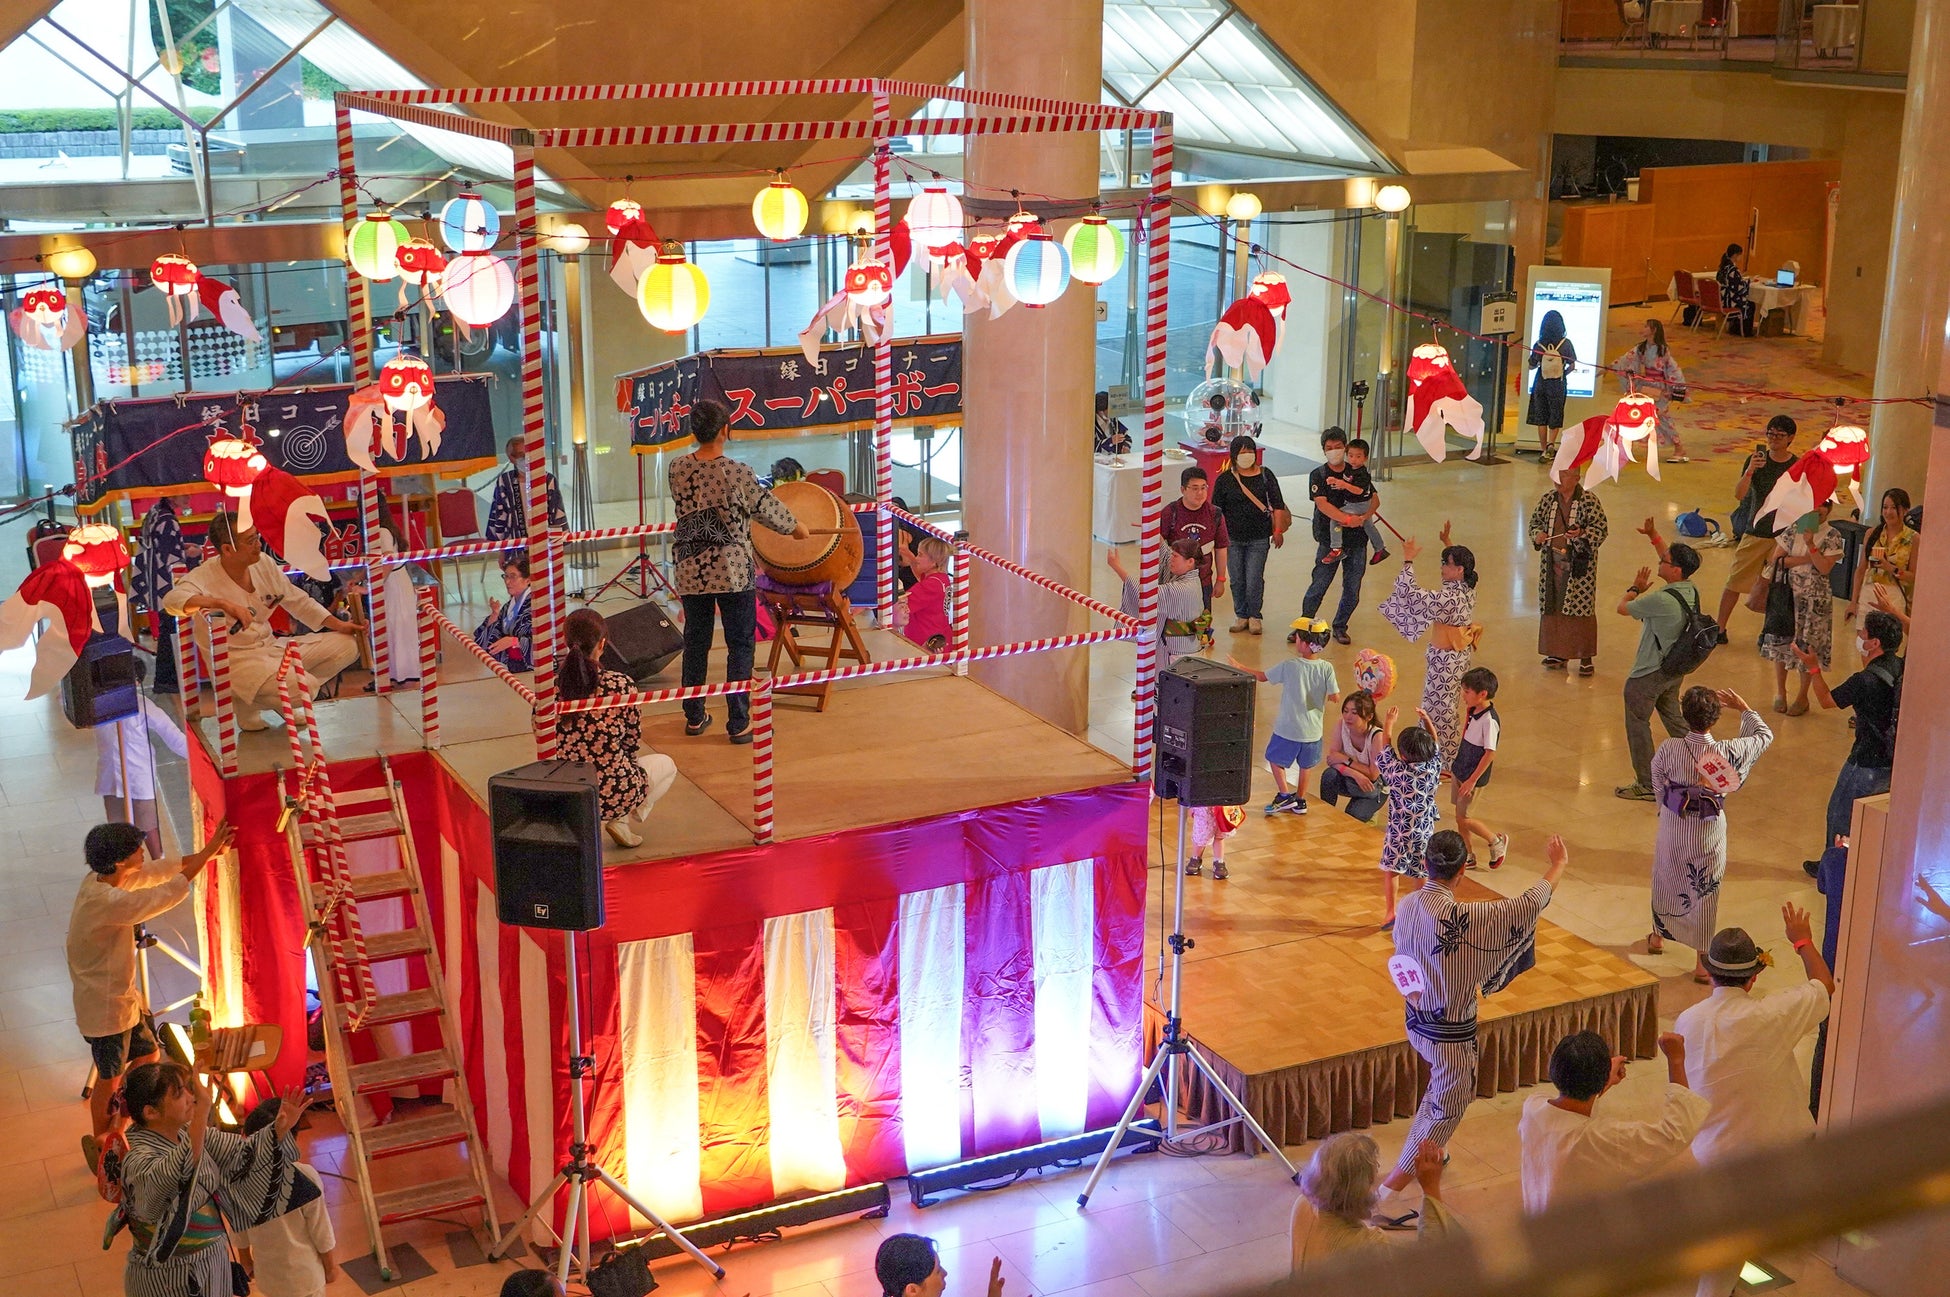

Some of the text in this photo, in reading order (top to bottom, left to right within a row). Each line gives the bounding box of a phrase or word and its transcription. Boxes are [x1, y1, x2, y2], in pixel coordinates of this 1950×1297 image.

[780, 350, 948, 381] 縁日コナー
[725, 370, 963, 427] スーパーボー
[201, 405, 338, 428] 縁日コー
